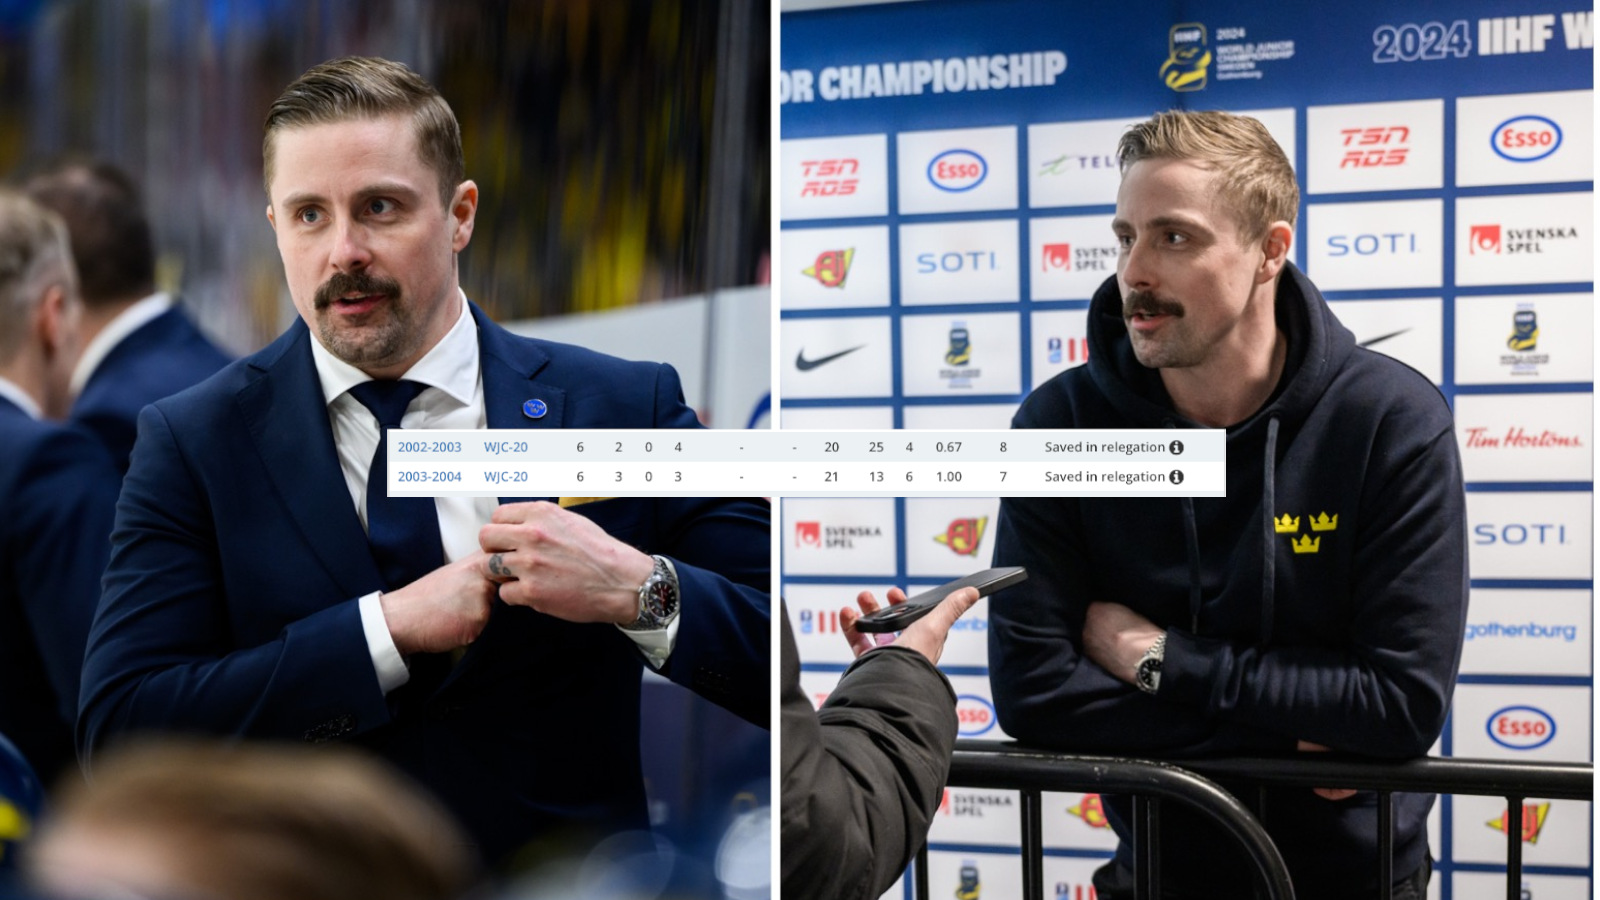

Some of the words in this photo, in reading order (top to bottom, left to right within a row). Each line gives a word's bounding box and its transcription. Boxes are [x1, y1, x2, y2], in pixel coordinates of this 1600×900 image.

[1372, 20, 1472, 63] 2024
[1478, 14, 1555, 56] IIHF
[818, 50, 1067, 101] CHAMPIONSHIP
[1340, 126, 1410, 146] TSN
[1502, 128, 1553, 148] Esso
[800, 158, 860, 178] TSN
[936, 161, 980, 180] Esso
[1506, 226, 1578, 242] SVENSKA
[1327, 233, 1416, 257] SOTI
[1507, 241, 1543, 254] SPEL
[917, 251, 996, 273] SOTI
[1075, 260, 1107, 272] SPEL
[1466, 427, 1500, 448] Tim
[1503, 426, 1580, 448] Hortons
[825, 525, 882, 538] SVENSKA
[1474, 524, 1565, 545] SOTI
[825, 537, 855, 549] SPEL
[1464, 622, 1577, 642] gothenburg
[1497, 716, 1546, 737] Esso
[953, 794, 1012, 806] SVENSKA
[953, 805, 984, 817] SPEL
